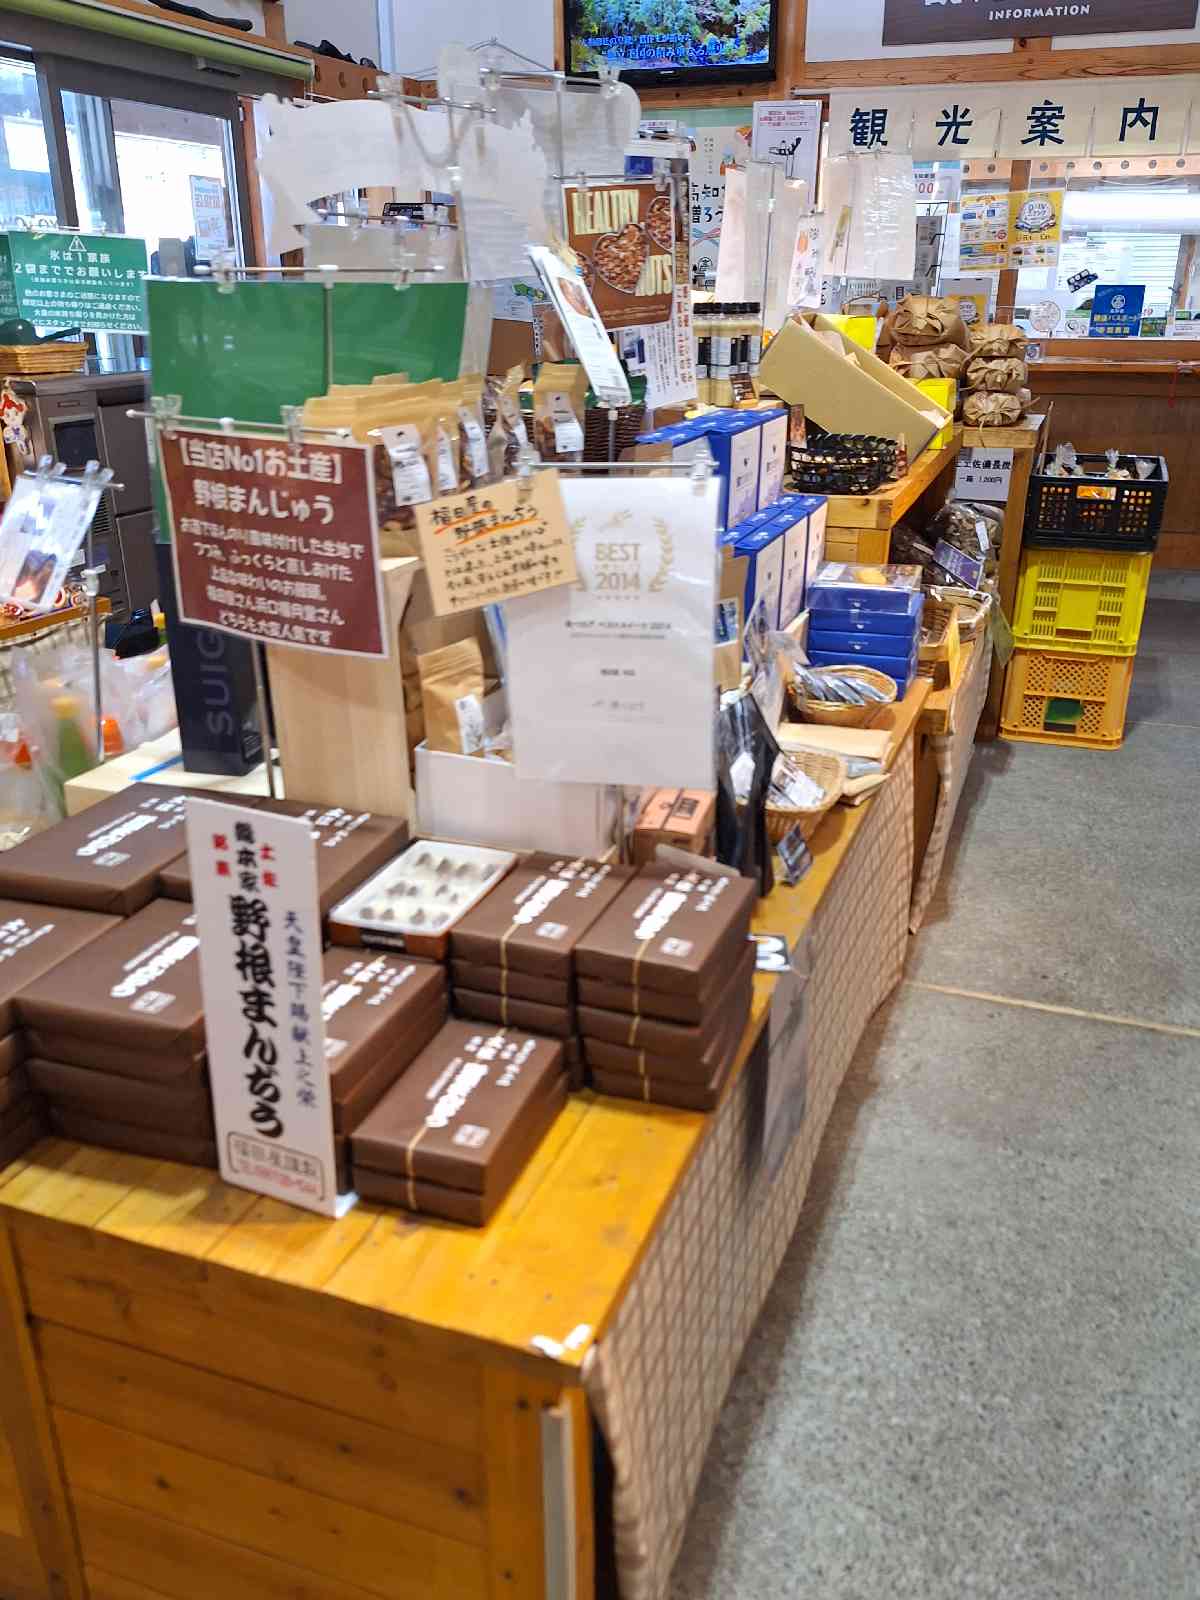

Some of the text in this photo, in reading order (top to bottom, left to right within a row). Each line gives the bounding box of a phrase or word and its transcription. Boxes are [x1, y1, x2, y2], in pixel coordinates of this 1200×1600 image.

[988, 4, 1091, 21] INFORMATION
[849, 97, 1160, 150] 観光案内
[192, 478, 335, 524] 野根まんじゅう
[594, 543, 641, 562] BEST
[595, 572, 642, 592] 2014
